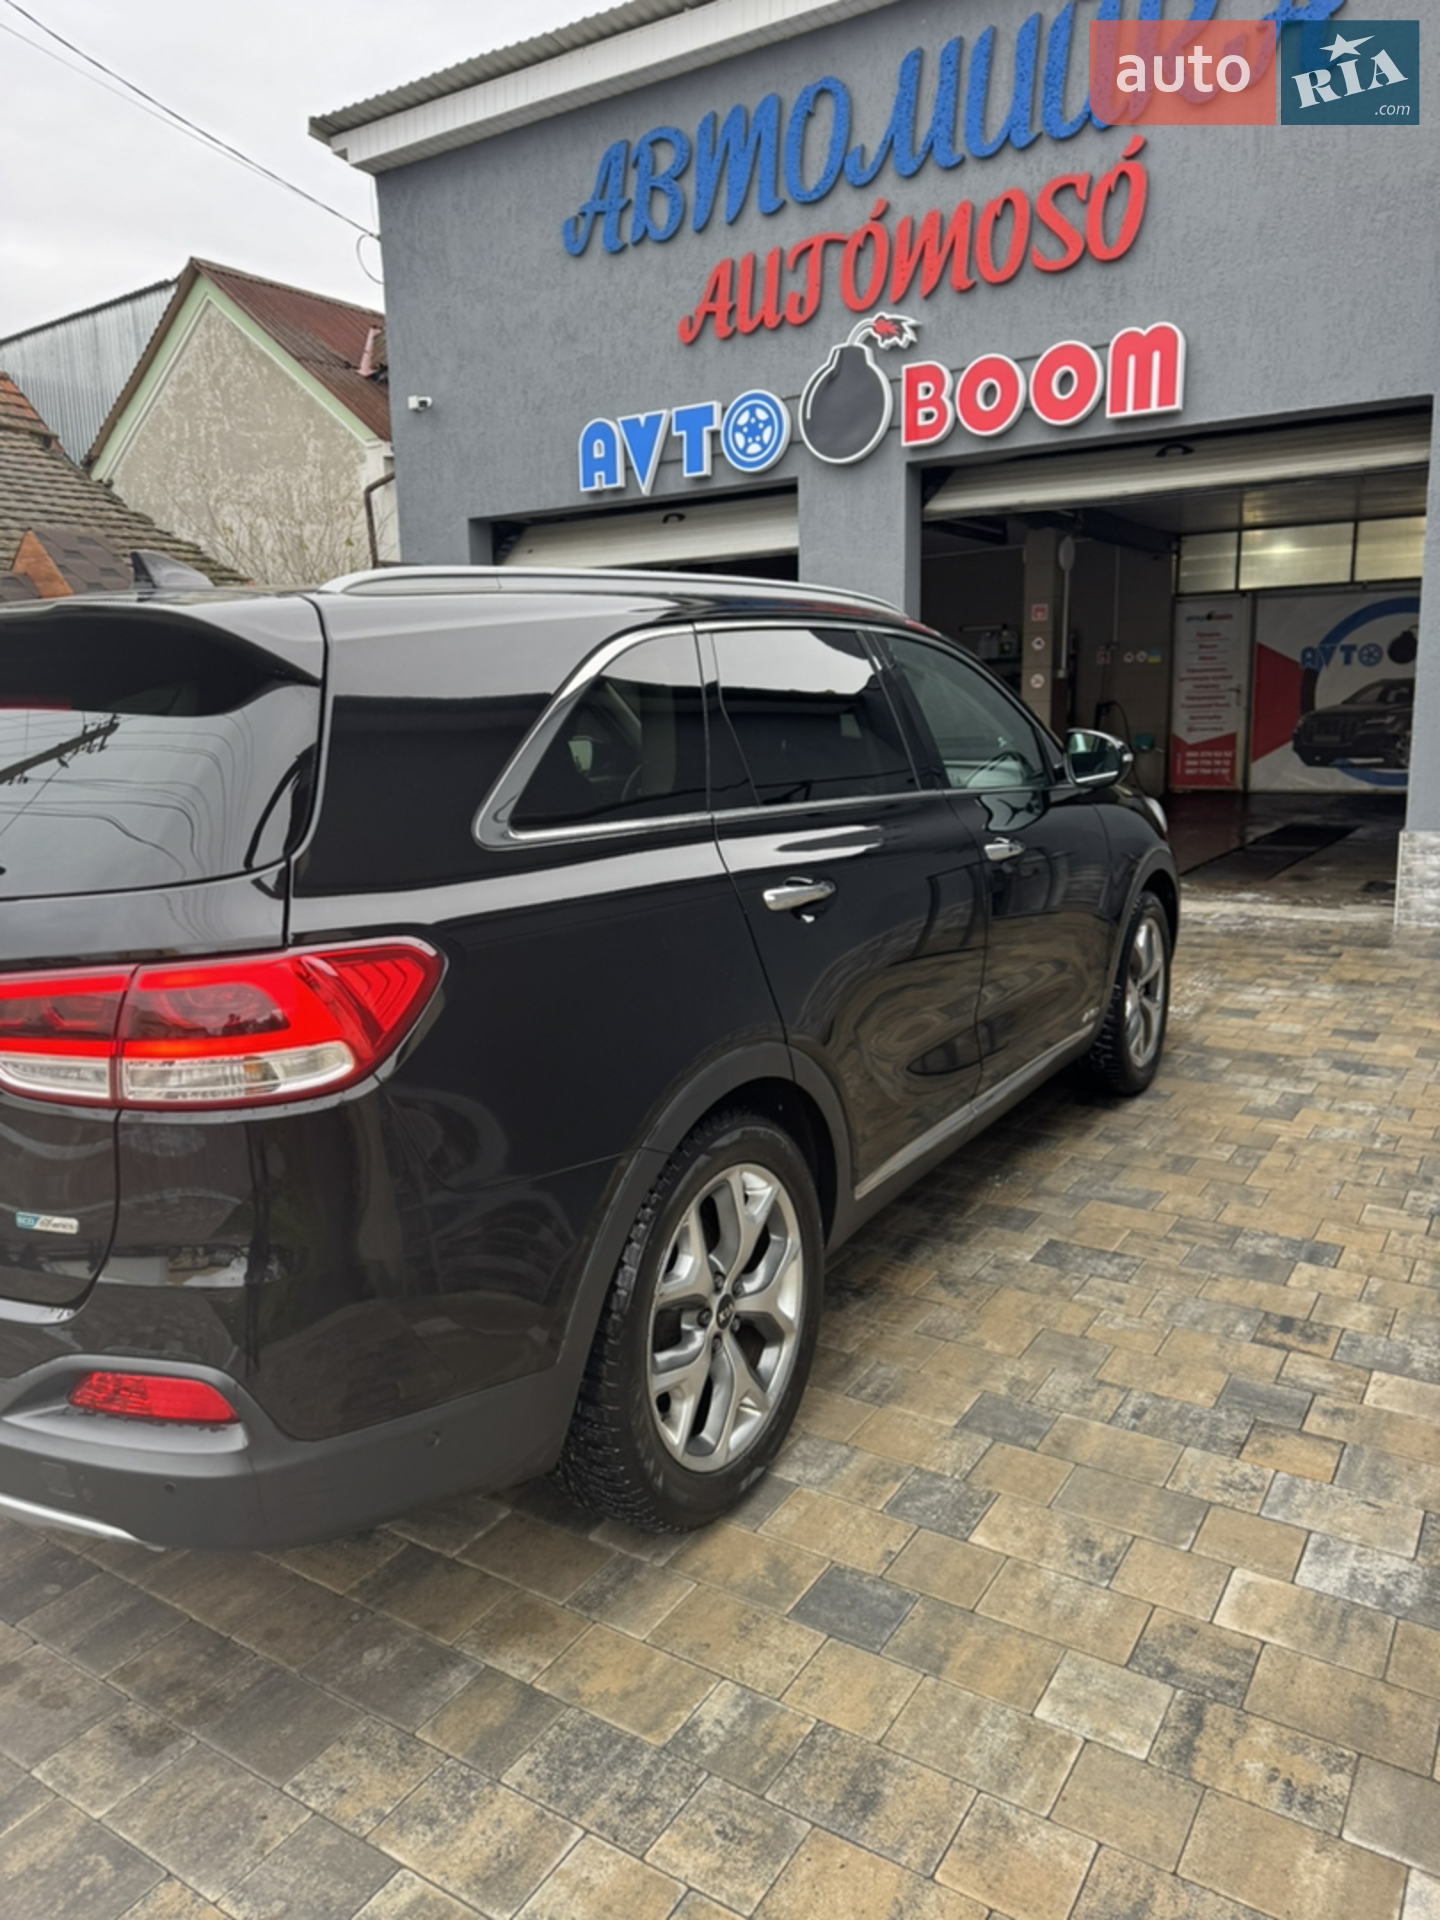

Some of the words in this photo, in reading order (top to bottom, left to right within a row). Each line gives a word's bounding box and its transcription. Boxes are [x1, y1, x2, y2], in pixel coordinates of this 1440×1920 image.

[678, 135, 1148, 345] AUTÓMOSÓ
[578, 388, 791, 495] AVTO
[902, 322, 1186, 448] BOOM
